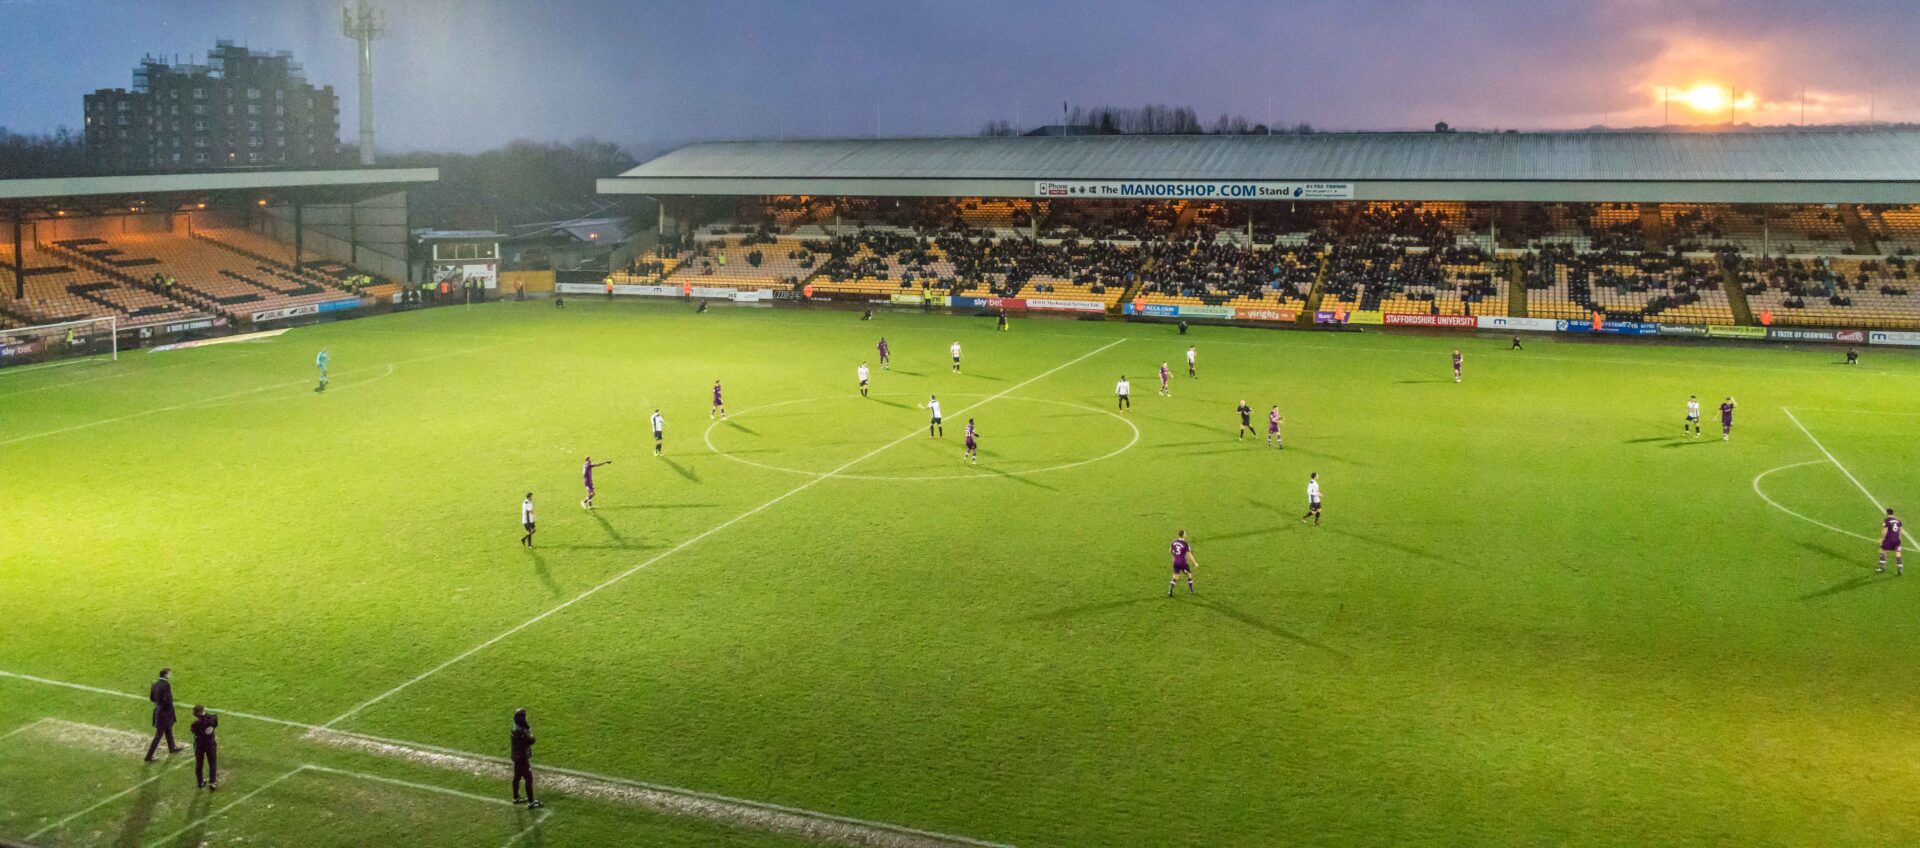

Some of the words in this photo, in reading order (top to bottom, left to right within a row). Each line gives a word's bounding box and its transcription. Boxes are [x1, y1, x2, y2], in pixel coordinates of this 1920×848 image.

[1101, 186, 1118, 194] The
[1121, 184, 1256, 196] MANORSHOP.COM
[1259, 186, 1289, 196] Stand
[974, 297, 987, 307] sky
[989, 297, 1003, 307] bet
[297, 304, 318, 315] CARLING
[264, 310, 285, 320] CARLING
[1247, 310, 1280, 320] Wrights
[1386, 315, 1436, 325] STAFFORDSHIRE
[1438, 316, 1475, 326] UNIVERSITY
[1803, 332, 1834, 340] CORNWALL
[2, 348, 16, 357] sky
[18, 345, 33, 355] bet
